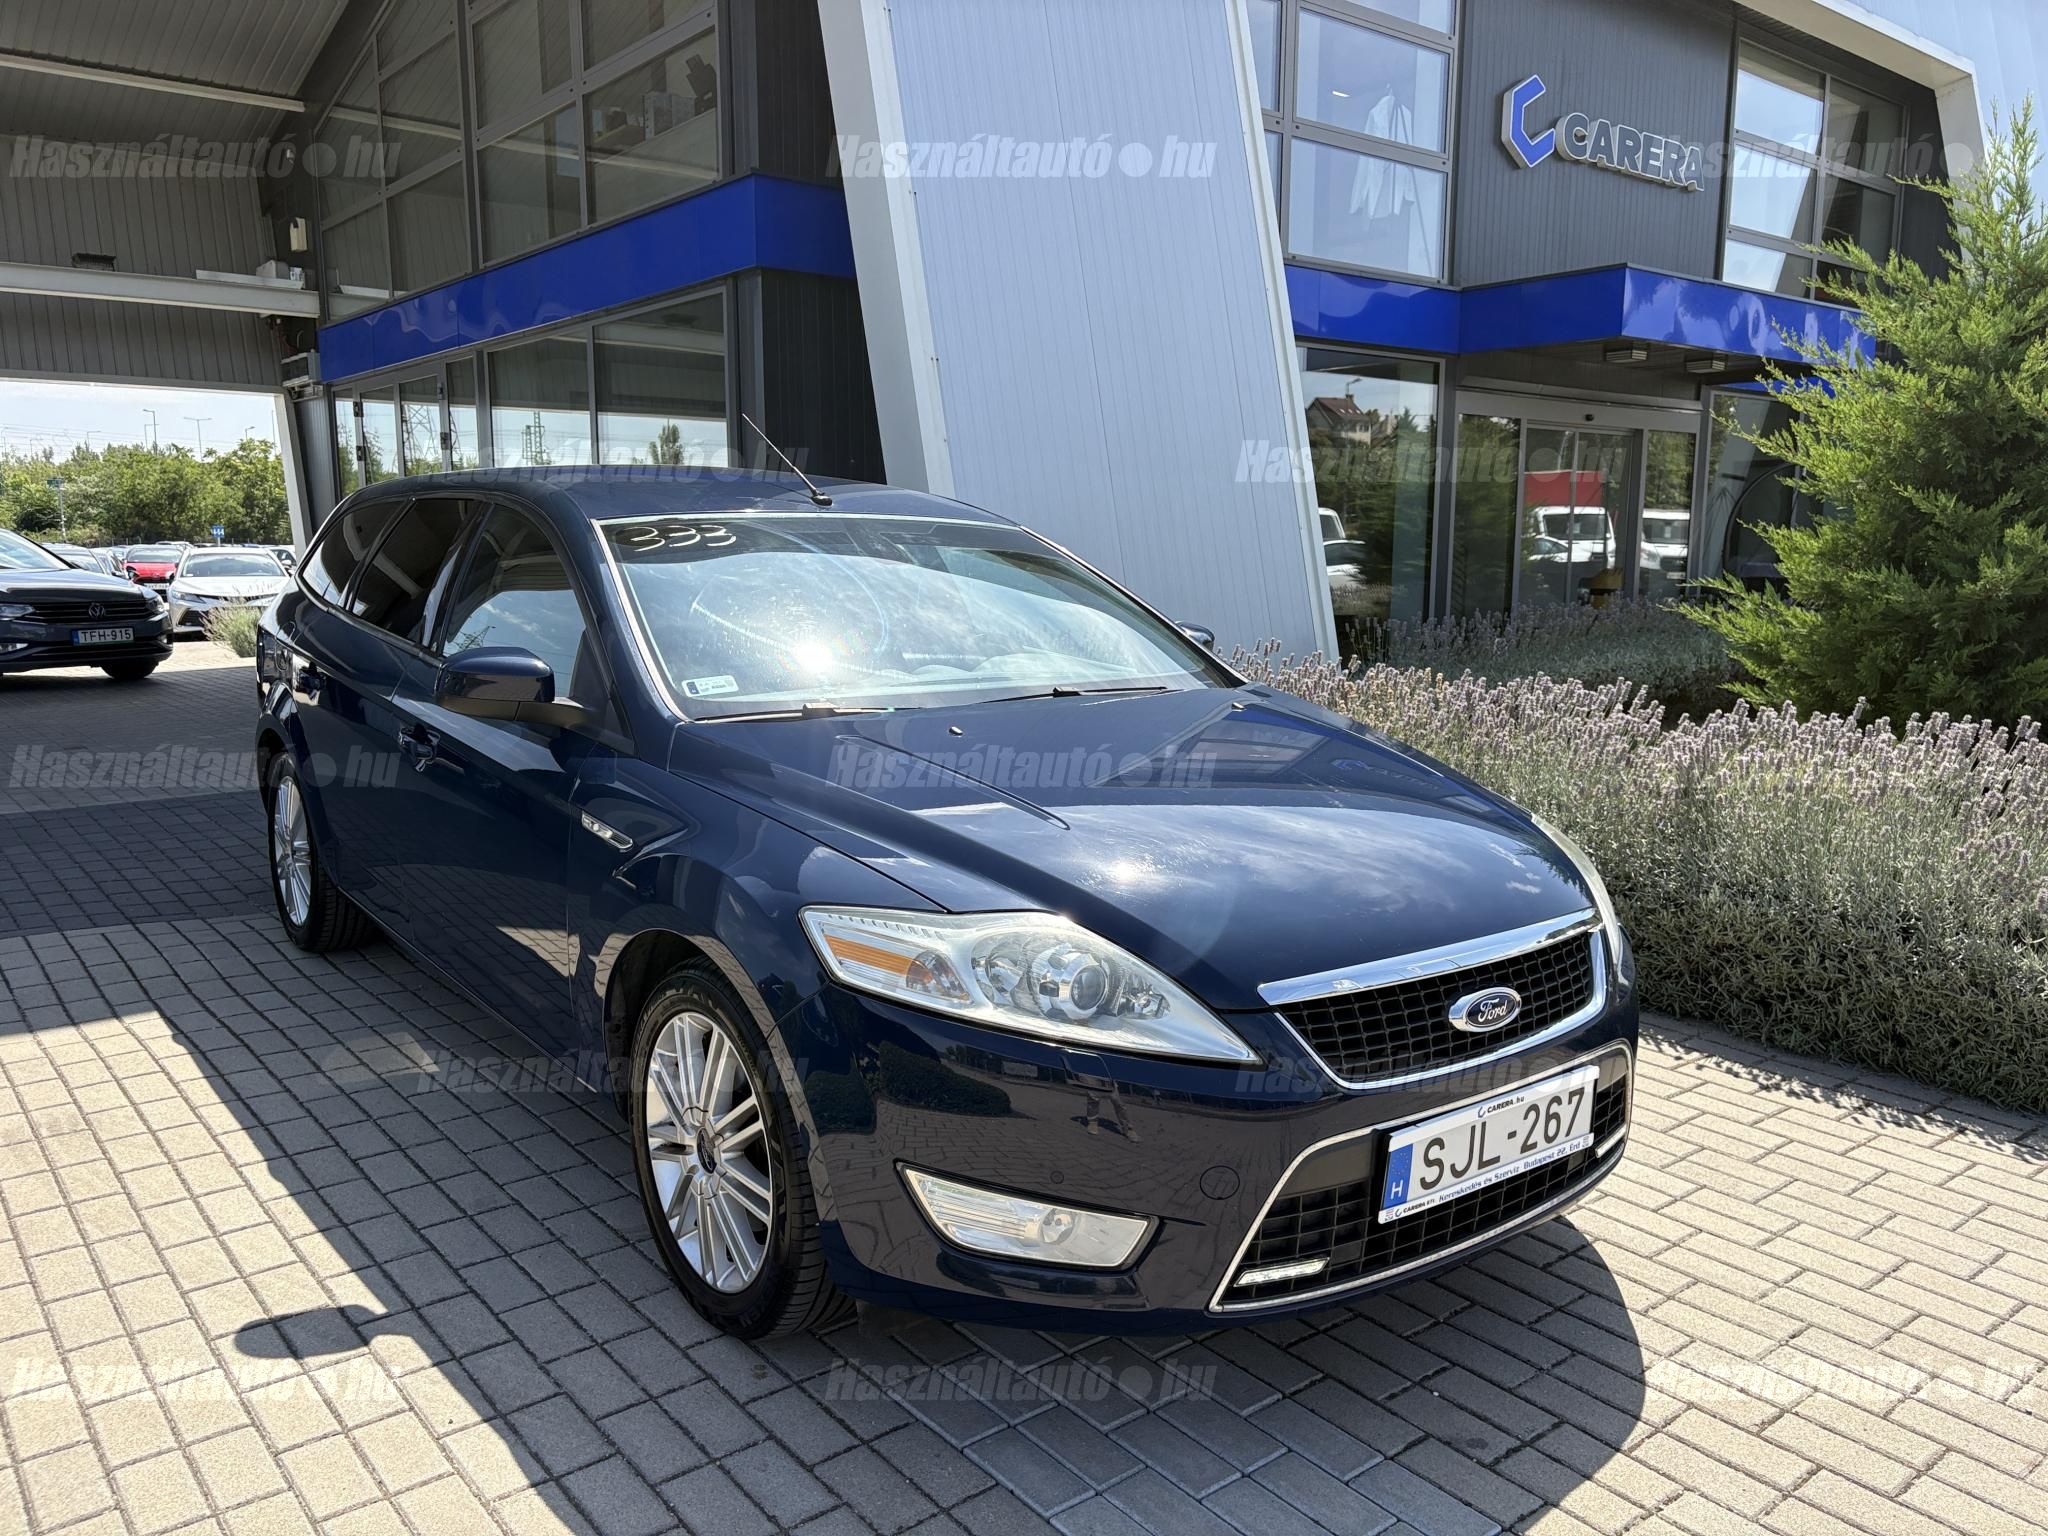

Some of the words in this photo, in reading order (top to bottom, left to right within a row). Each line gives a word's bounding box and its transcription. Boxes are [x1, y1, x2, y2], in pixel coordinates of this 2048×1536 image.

[1556, 113, 1705, 192] CARERA
[624, 525, 737, 552] 333
[81, 629, 131, 642] TFH-915
[1478, 998, 1508, 1023] Ford
[1420, 1087, 1586, 1191] SJL-267
[1390, 1179, 1404, 1200] H
